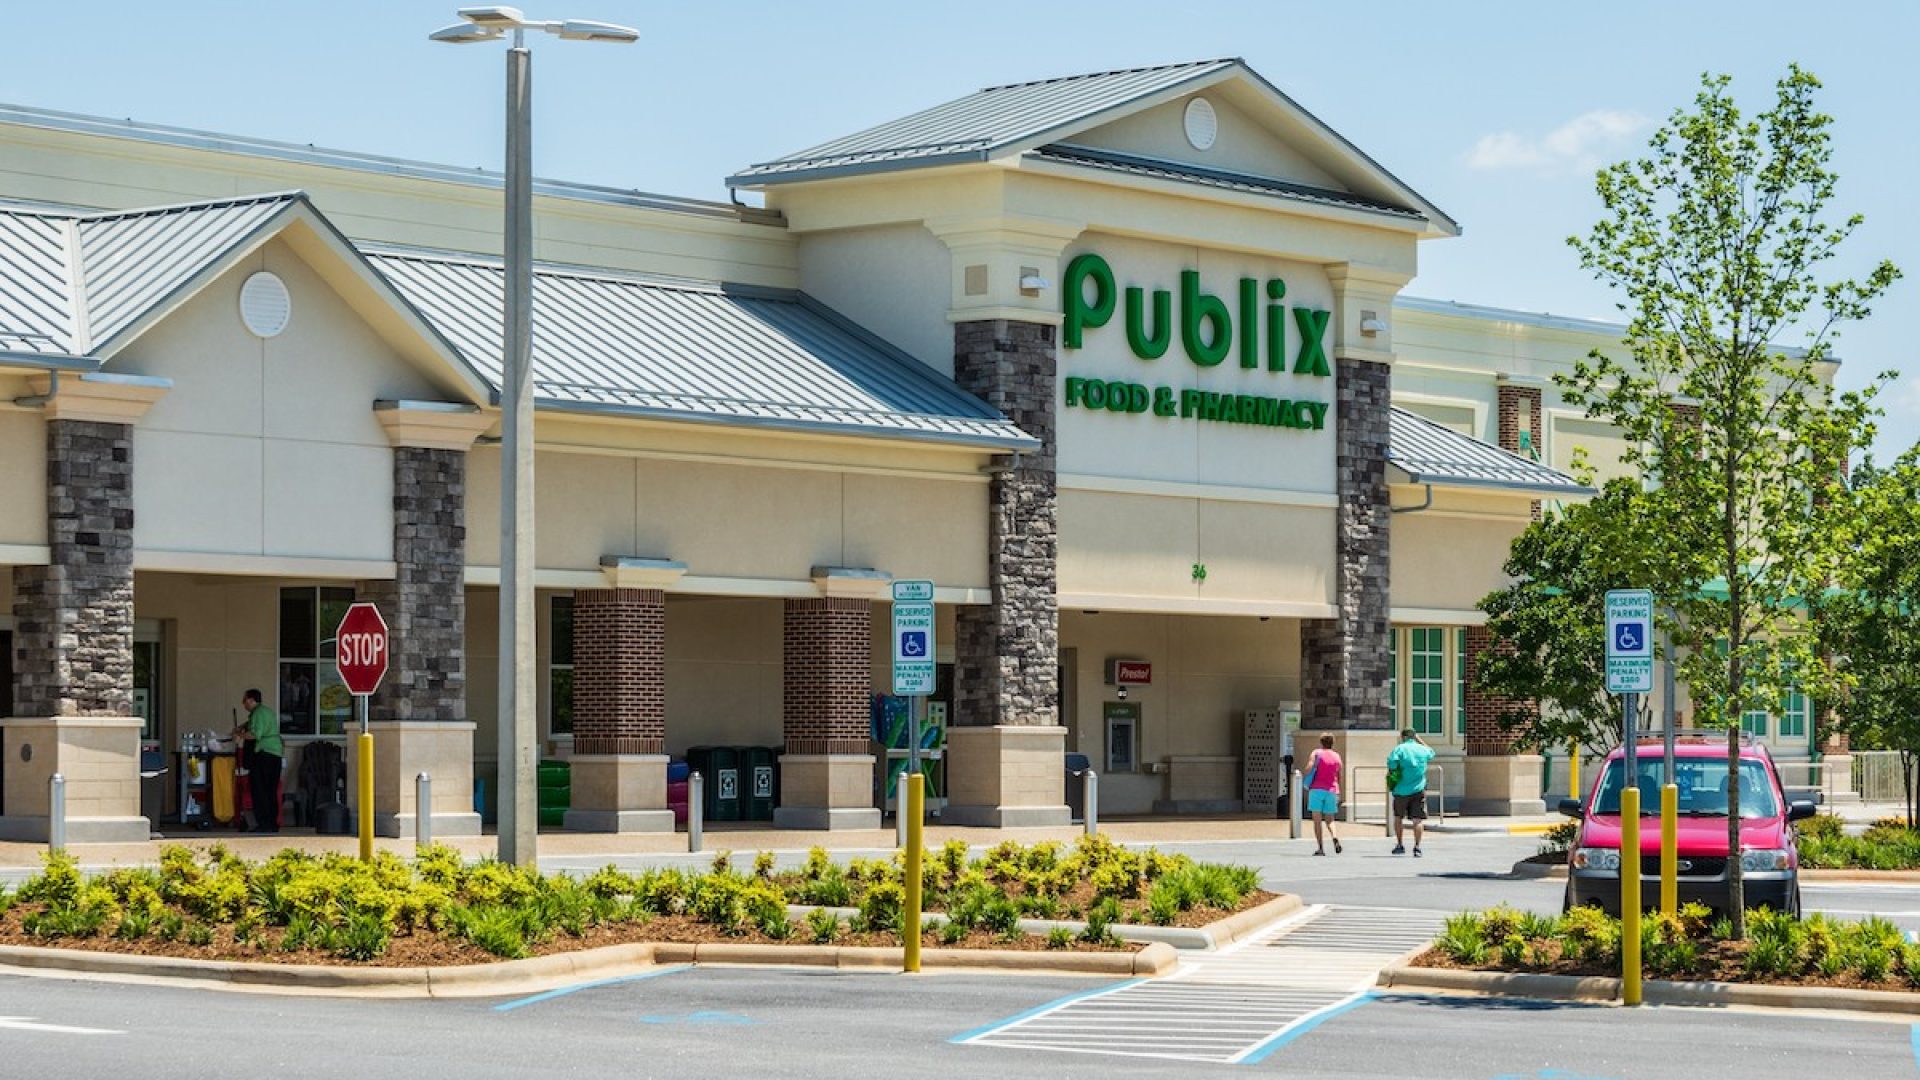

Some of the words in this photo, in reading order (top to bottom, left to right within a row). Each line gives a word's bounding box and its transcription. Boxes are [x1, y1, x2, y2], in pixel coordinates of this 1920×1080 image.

[1063, 254, 1331, 376] Publix
[1065, 376, 1150, 413] FOOD
[1153, 386, 1177, 417] &
[1181, 389, 1328, 430] PHARMACY
[1191, 564, 1207, 580] 36
[1608, 597, 1649, 606] RESERVED
[896, 607, 932, 616] RESERVED
[1611, 609, 1647, 618] PARKING
[897, 618, 929, 627] PARKING
[340, 633, 385, 667] STOP
[1120, 667, 1150, 680] Presto!
